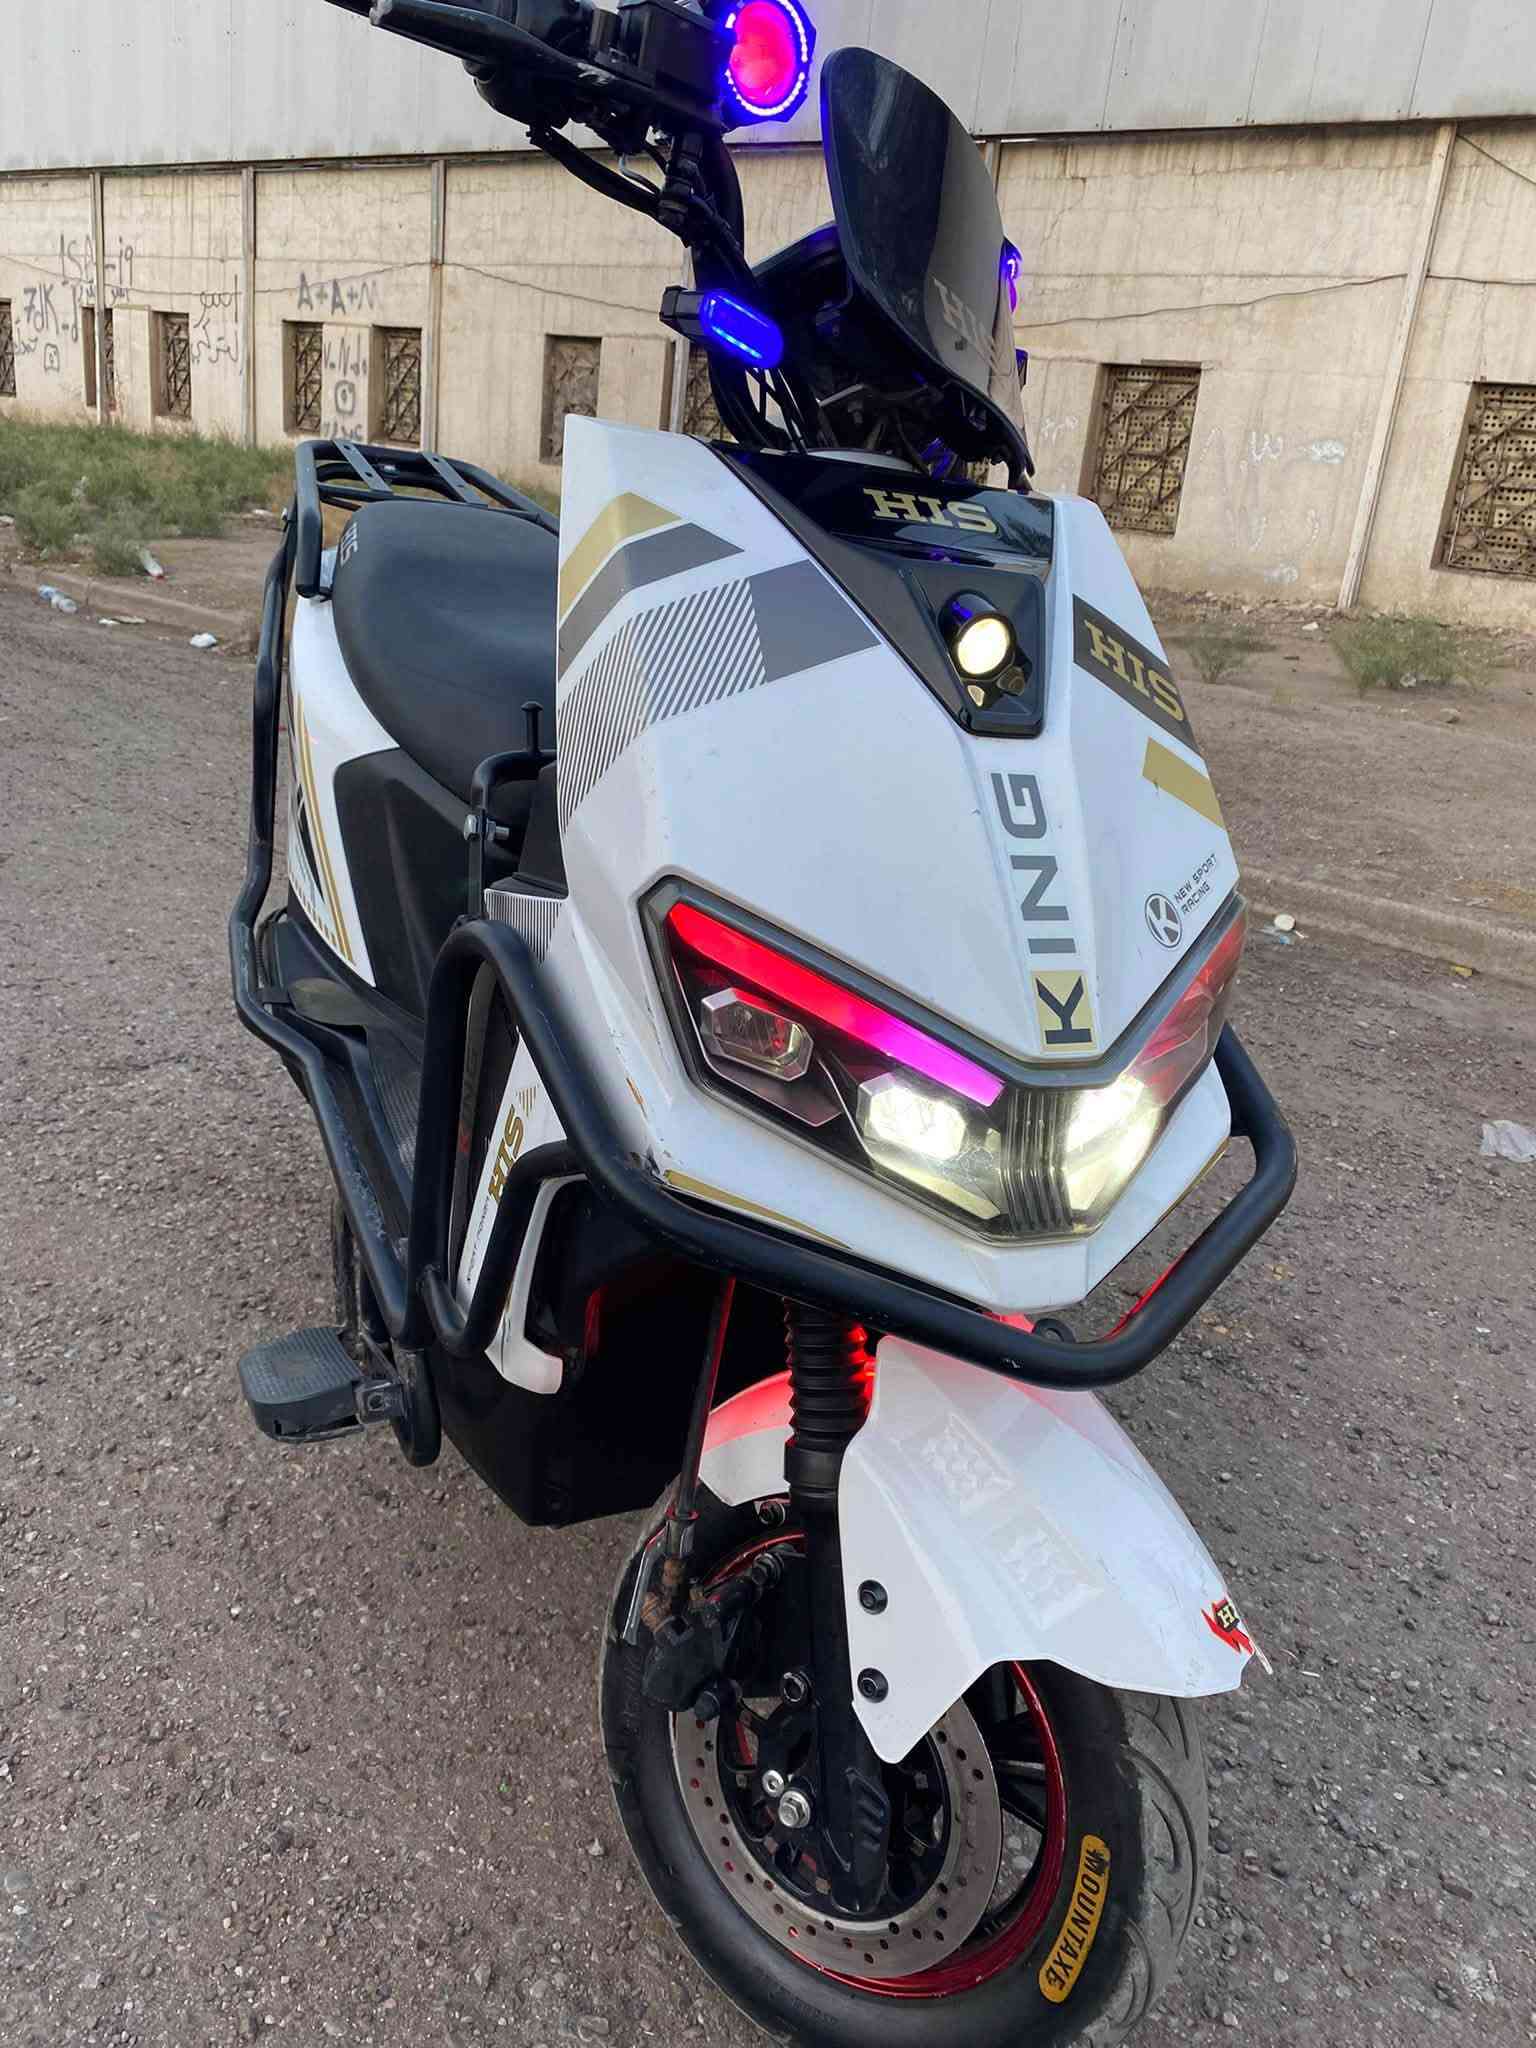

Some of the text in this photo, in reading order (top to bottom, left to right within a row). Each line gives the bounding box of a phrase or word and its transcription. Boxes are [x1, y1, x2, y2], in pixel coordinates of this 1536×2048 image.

[863, 487, 998, 534] HIS
[1083, 619, 1184, 721] HIS
[990, 772, 1093, 1045] KING
[1174, 853, 1217, 904] NEW SPORT
[1181, 880, 1210, 914] RACING
[488, 1104, 524, 1204] HIS
